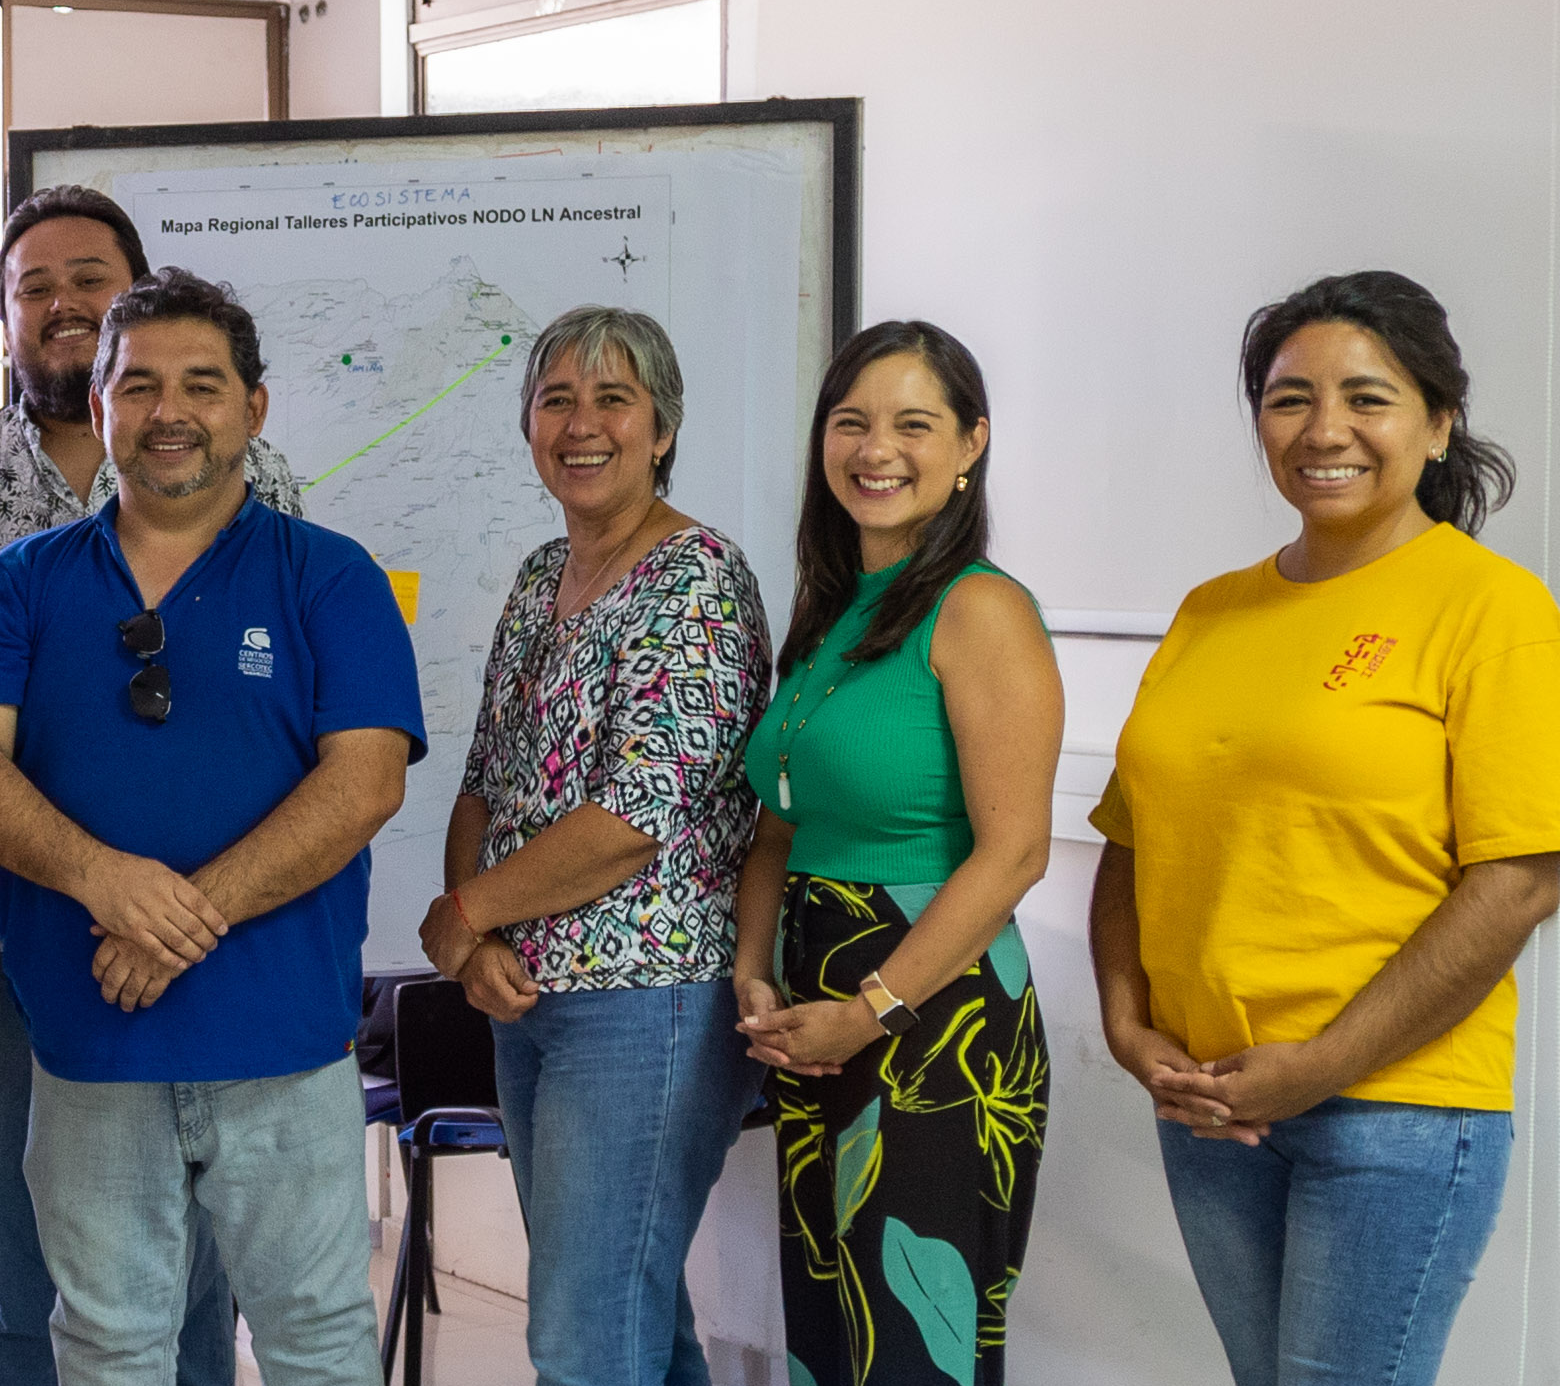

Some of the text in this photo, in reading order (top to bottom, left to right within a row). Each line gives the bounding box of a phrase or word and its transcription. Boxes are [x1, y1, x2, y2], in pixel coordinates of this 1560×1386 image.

[161, 205, 641, 235] Mapa Regional Talleres Participativos NODO LN Ancestral
